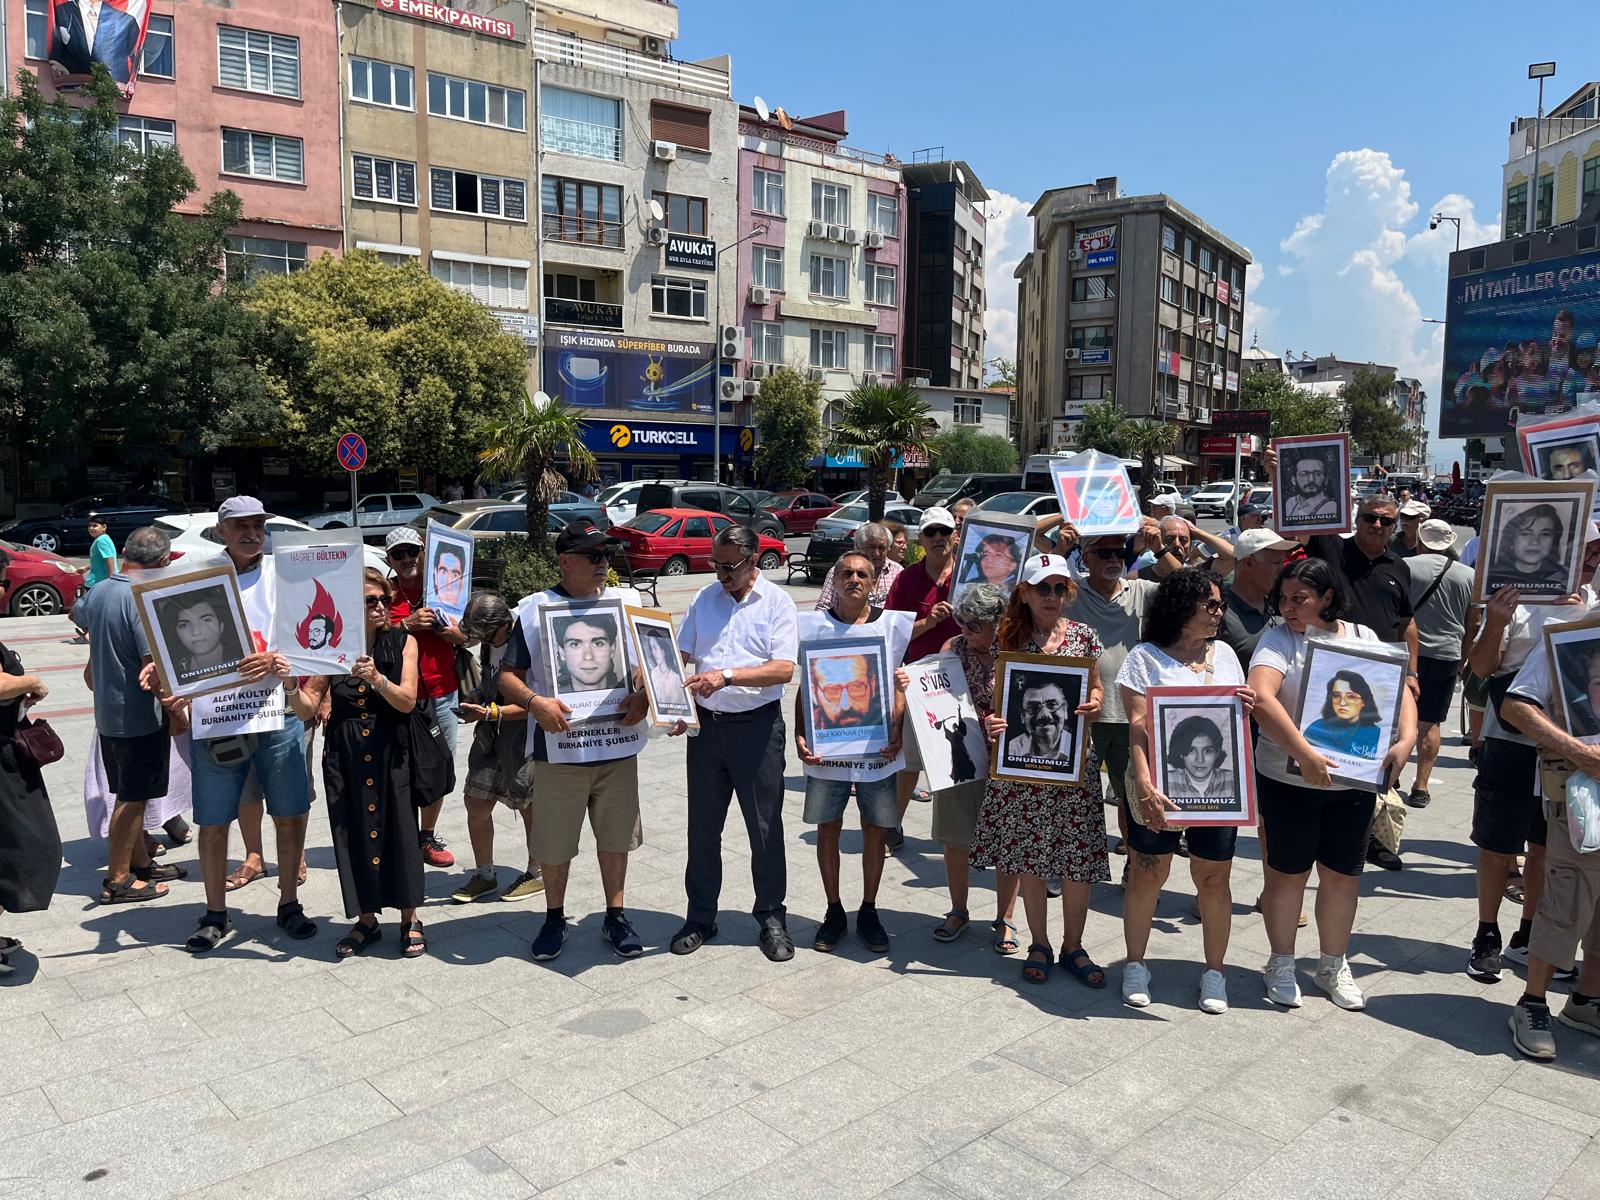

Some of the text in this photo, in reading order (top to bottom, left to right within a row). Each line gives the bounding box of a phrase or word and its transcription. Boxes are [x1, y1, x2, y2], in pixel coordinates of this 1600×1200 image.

[399, 0, 446, 21] EMEK
[669, 239, 714, 256] AVUKAT
[1485, 271, 1555, 299] TATİLLER
[571, 302, 622, 316] AVUKAT
[560, 335, 701, 354] IŞIK HIZINDA SÜPERFİBER BURADA
[631, 429, 698, 445] TURKCELL
[291, 550, 347, 562] HASRET GÜLTEKİN
[1040, 555, 1050, 567] B
[180, 660, 240, 679] ONURUMUZ
[212, 688, 278, 704] ALEVİ KÜLTÜR
[214, 700, 275, 713] DERNEKLERİ
[569, 700, 593, 710] MURAT
[201, 712, 254, 726] BURHANİYE
[558, 732, 640, 750] BURHANİYE ŞUBESİ
[819, 760, 867, 770] URHANİYE
[1007, 755, 1070, 767] ONURUMUZ
